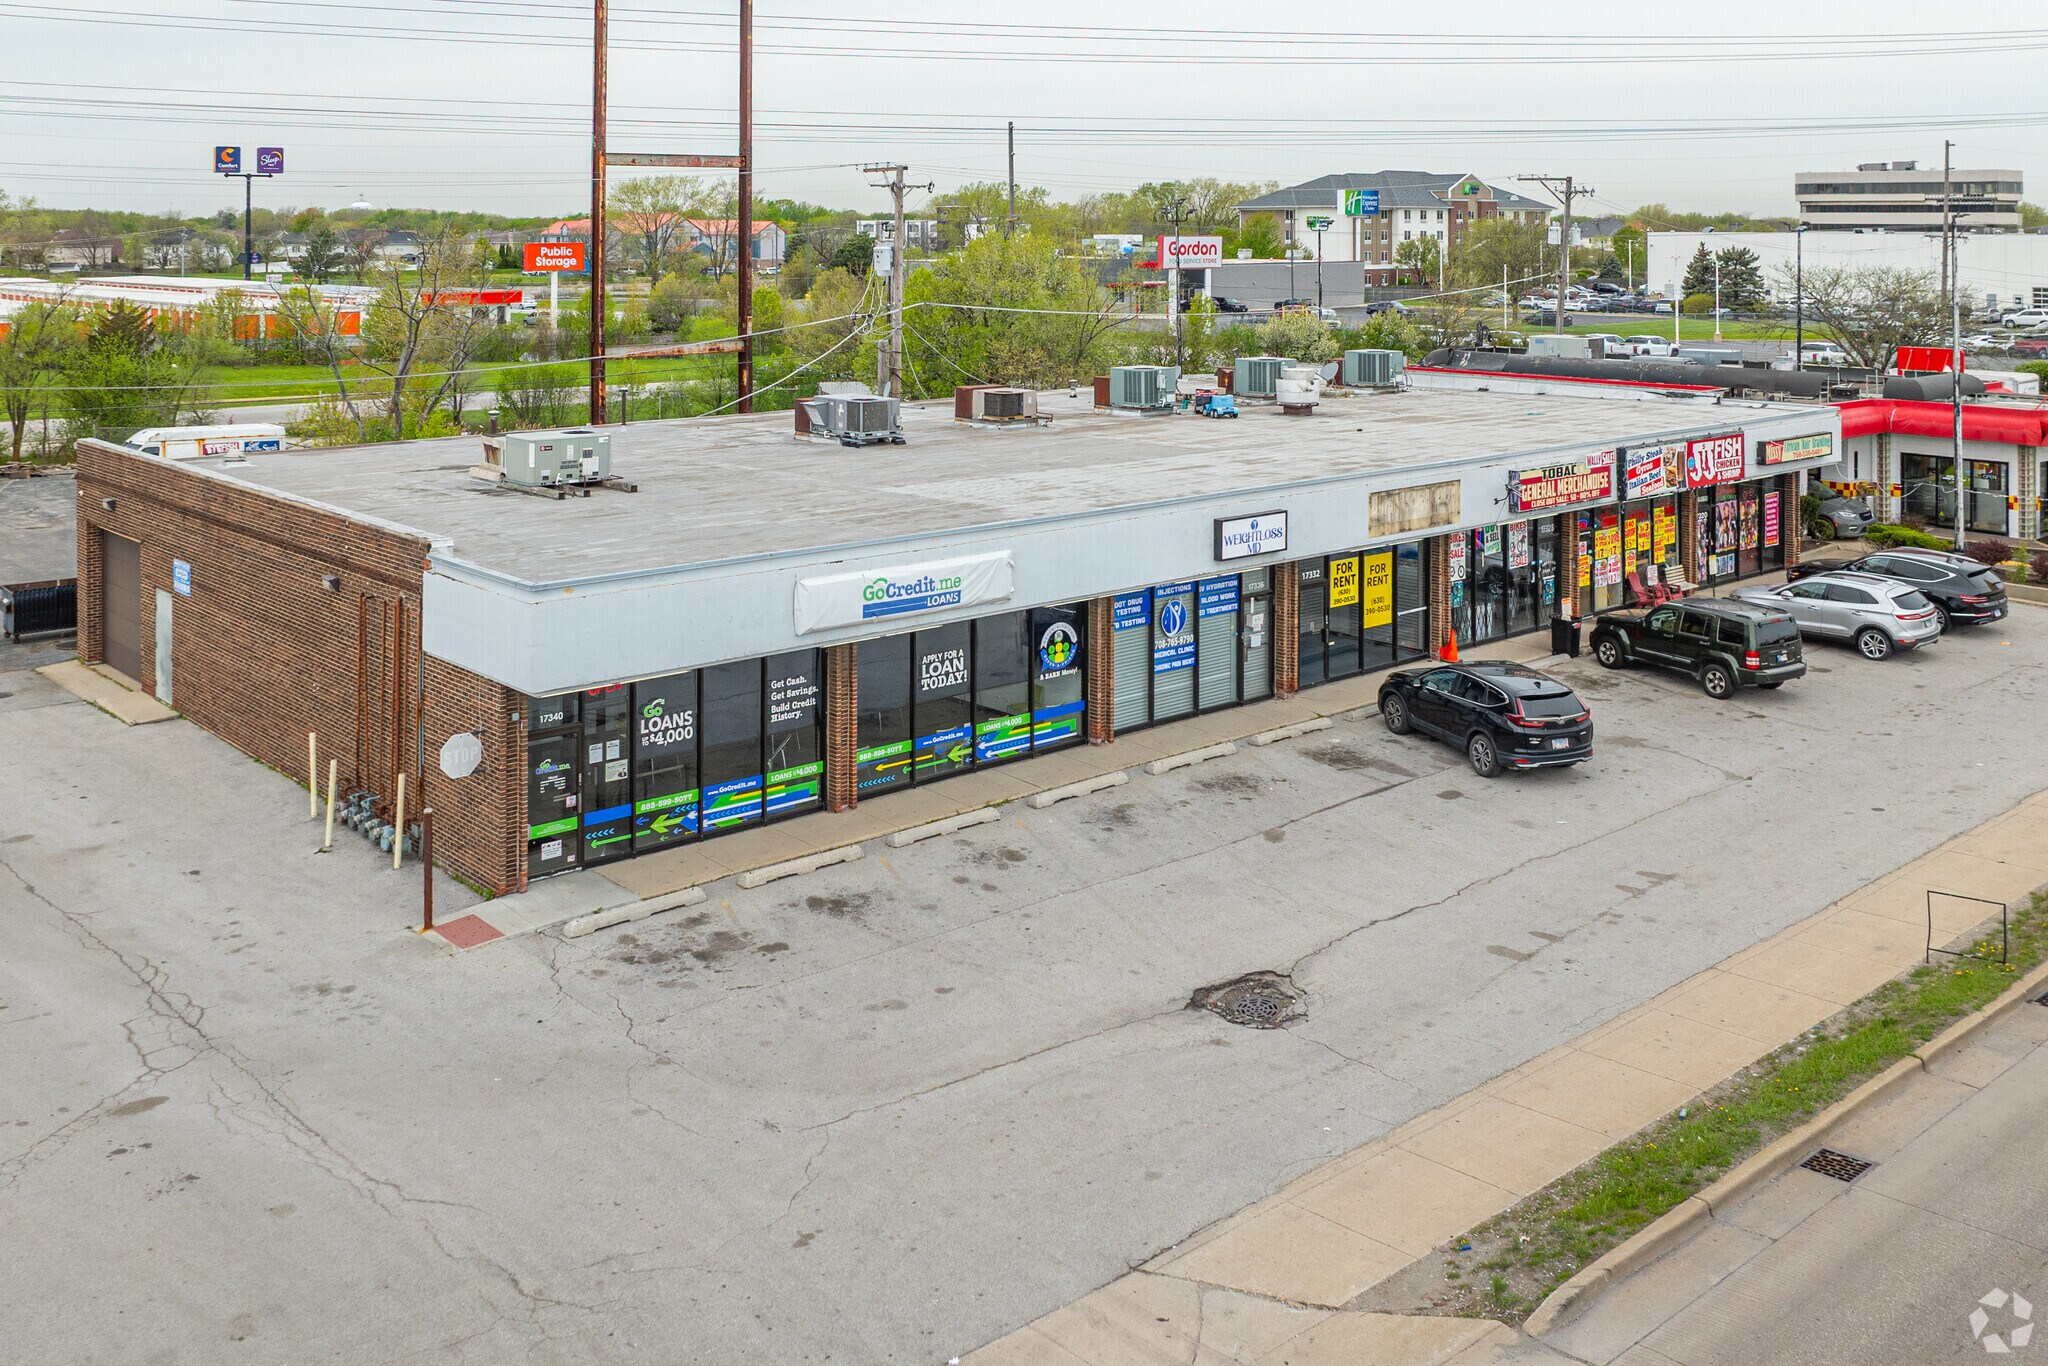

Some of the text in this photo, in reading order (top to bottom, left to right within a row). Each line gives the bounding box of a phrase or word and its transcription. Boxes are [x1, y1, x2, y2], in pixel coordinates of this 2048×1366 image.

[260, 154, 279, 166] Sleep
[541, 246, 573, 256] Public
[1169, 240, 1217, 256] Gordon
[535, 256, 577, 268] Storage
[1715, 437, 1742, 459] FISH
[1628, 447, 1663, 468] Philly Steak
[1636, 462, 1653, 475] Gyros
[1715, 460, 1741, 471] CHICKEN
[1628, 468, 1662, 490] Italian Beef
[1522, 480, 1556, 502] GENERAL
[1558, 472, 1609, 495] MERCHANDISE
[1641, 480, 1664, 494] Seafood
[1531, 499, 1545, 508] CLOSE
[1546, 498, 1555, 506] OUT
[1592, 489, 1600, 498] OFF
[1510, 521, 1527, 531] BIKES
[1224, 527, 1283, 546] WEIGHTLOSS
[1450, 532, 1465, 543] BIKES
[1486, 532, 1499, 543] & SELL
[1450, 548, 1464, 559] SALE
[1515, 556, 1528, 567] SALE
[1336, 562, 1353, 574] FOR
[1369, 563, 1386, 574] FOR
[1302, 570, 1320, 580] 17332
[1333, 574, 1356, 588] RENT
[1367, 574, 1389, 587] RENT
[863, 576, 961, 602] GoCredit.me
[1157, 584, 1192, 596] INJECTIONS
[1206, 580, 1238, 591] HYDRATION
[1201, 592, 1235, 604] BLOOD WORK
[1338, 588, 1351, 596] (630)
[927, 592, 959, 607] LOANS
[1115, 598, 1143, 608] DOT DRUG
[1333, 595, 1356, 605] 390-0530
[1371, 596, 1385, 605] (630)
[1117, 606, 1141, 616] TESTING
[1206, 603, 1238, 614] TREATMENTS
[1365, 604, 1390, 615] 390-0530
[1121, 617, 1146, 627] TESTING
[922, 649, 964, 664] APPLY FOR A
[1154, 645, 1195, 659] MEDICAL CLINIC
[922, 657, 964, 678] LOAN
[921, 669, 968, 691] TODAY!
[1045, 671, 1061, 680] EARN
[771, 675, 807, 689] Get Cash.
[771, 685, 819, 700] Get Savings.
[643, 704, 663, 718] Go
[771, 697, 816, 713] Build Credit
[540, 712, 564, 723] 17340
[641, 710, 693, 734] LOANS
[771, 710, 803, 722] History.
[983, 722, 1001, 732] LOANS
[650, 726, 693, 747] $4,000
[443, 746, 479, 766] STOP
[859, 745, 902, 760] 888-599-5077
[771, 772, 792, 782] LOANS
[707, 780, 756, 795] www.GoCredit.me
[641, 793, 693, 811] 888-599-5077
